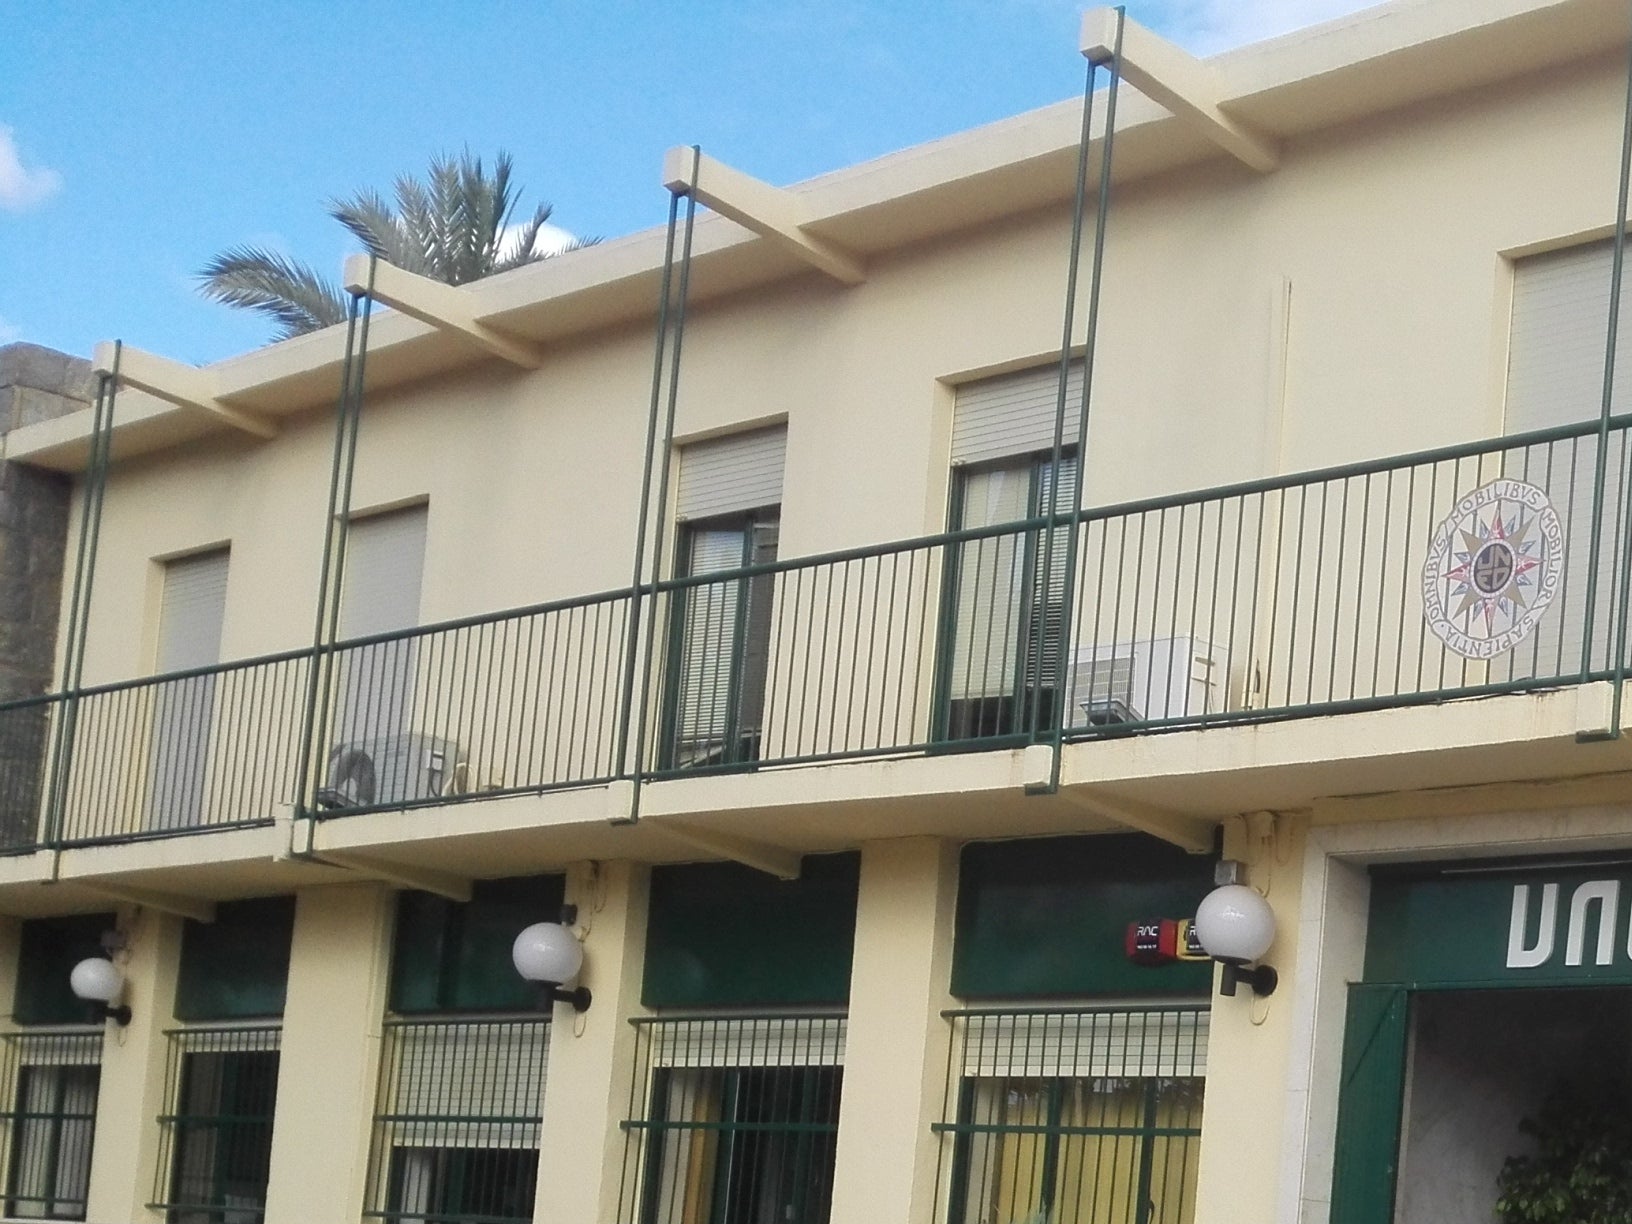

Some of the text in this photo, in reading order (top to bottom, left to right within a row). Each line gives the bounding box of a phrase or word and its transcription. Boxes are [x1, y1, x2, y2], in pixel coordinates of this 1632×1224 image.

[1425, 536, 1448, 624] OMNIBVS
[1451, 482, 1541, 525] MOBILIBVS
[1538, 511, 1563, 604] MOBILIOR
